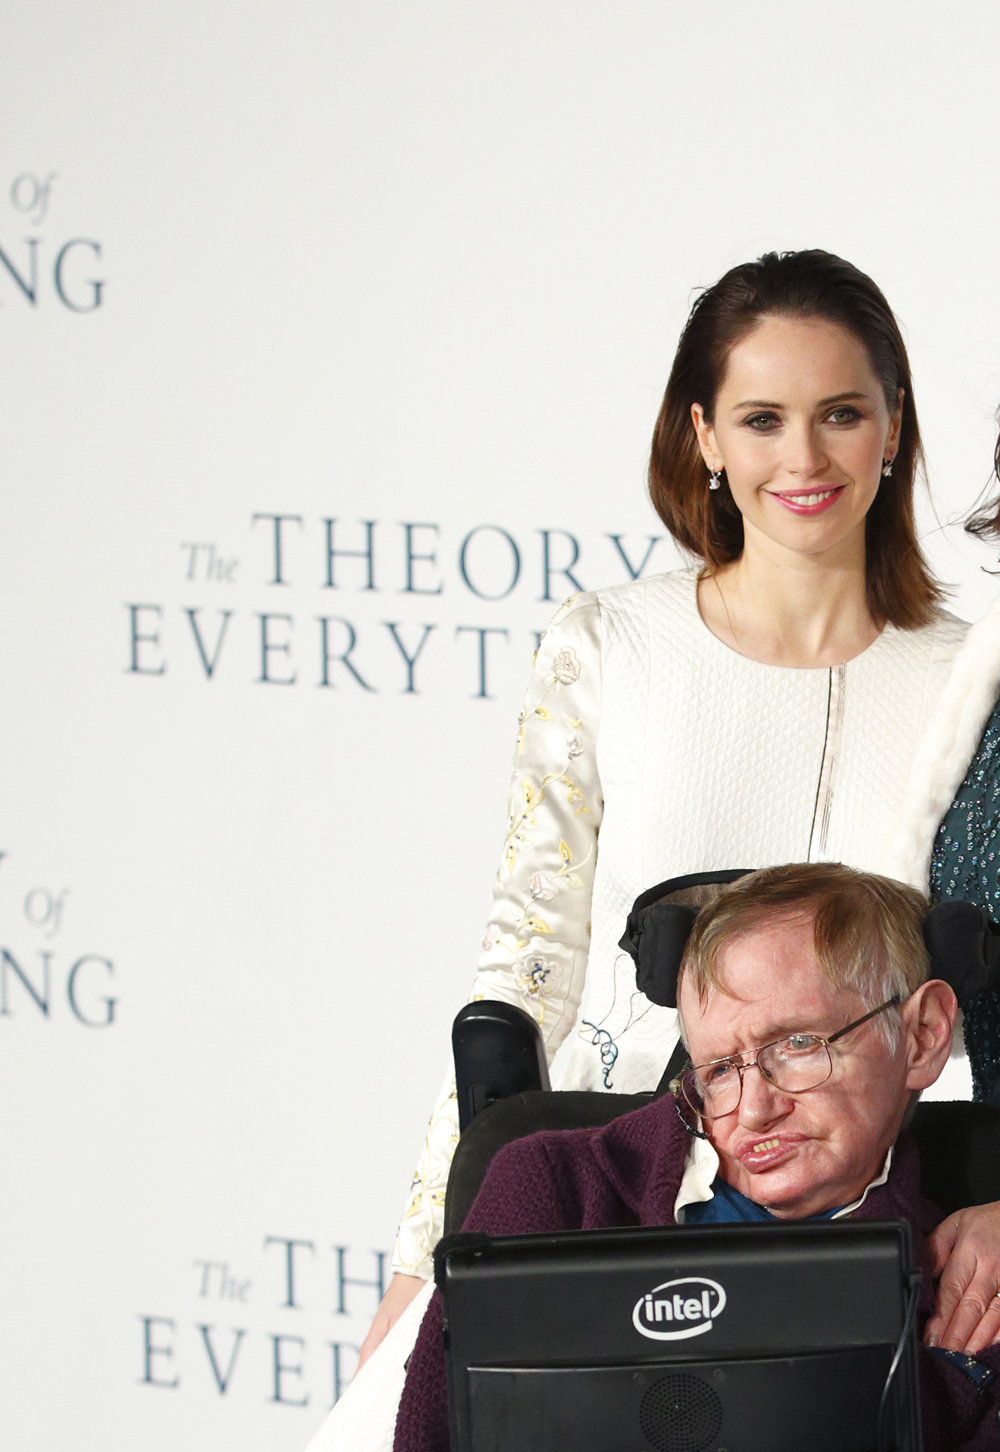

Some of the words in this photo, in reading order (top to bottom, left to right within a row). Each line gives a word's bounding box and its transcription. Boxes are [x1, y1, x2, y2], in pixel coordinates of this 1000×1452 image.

[9, 171, 58, 226] Of
[179, 539, 241, 584] The
[122, 600, 543, 701] EVERYT
[23, 886, 70, 939] Of
[0, 945, 119, 1029] NG
[193, 1258, 252, 1304] The
[644, 1289, 711, 1322] intel
